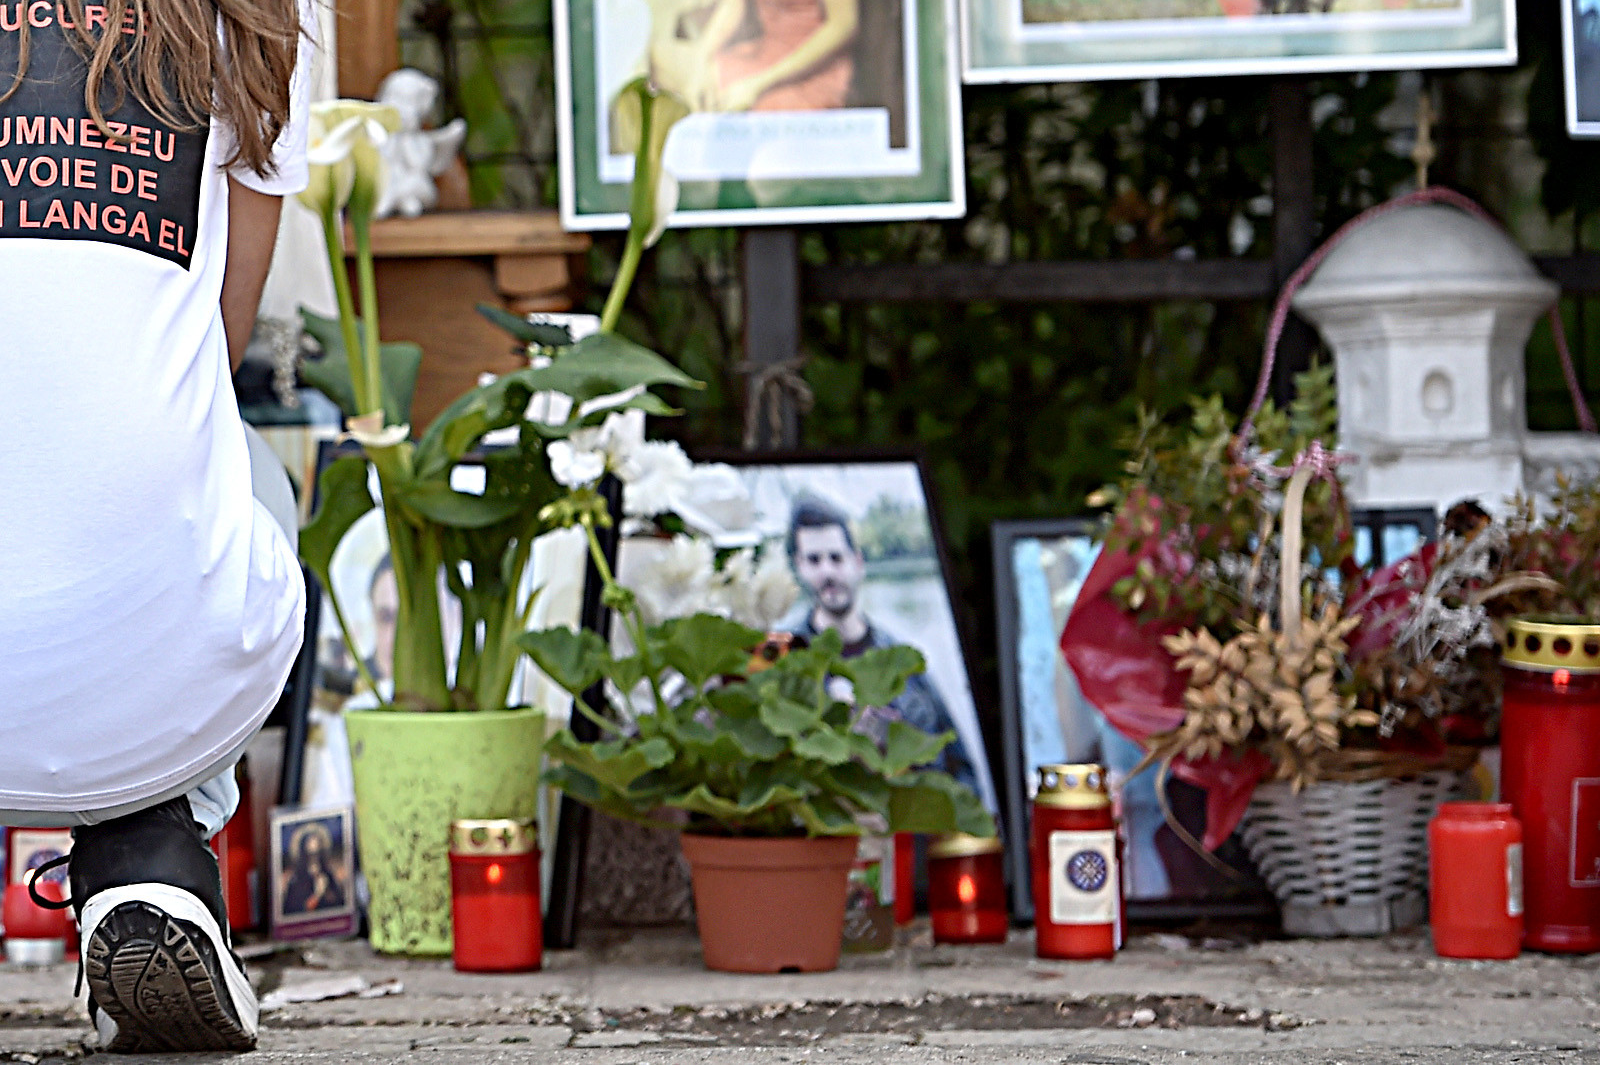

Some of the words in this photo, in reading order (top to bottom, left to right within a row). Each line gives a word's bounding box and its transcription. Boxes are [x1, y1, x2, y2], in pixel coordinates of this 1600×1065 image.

[110, 164, 159, 202] DE
[19, 199, 151, 243] LANGA
[158, 218, 190, 257] EL
